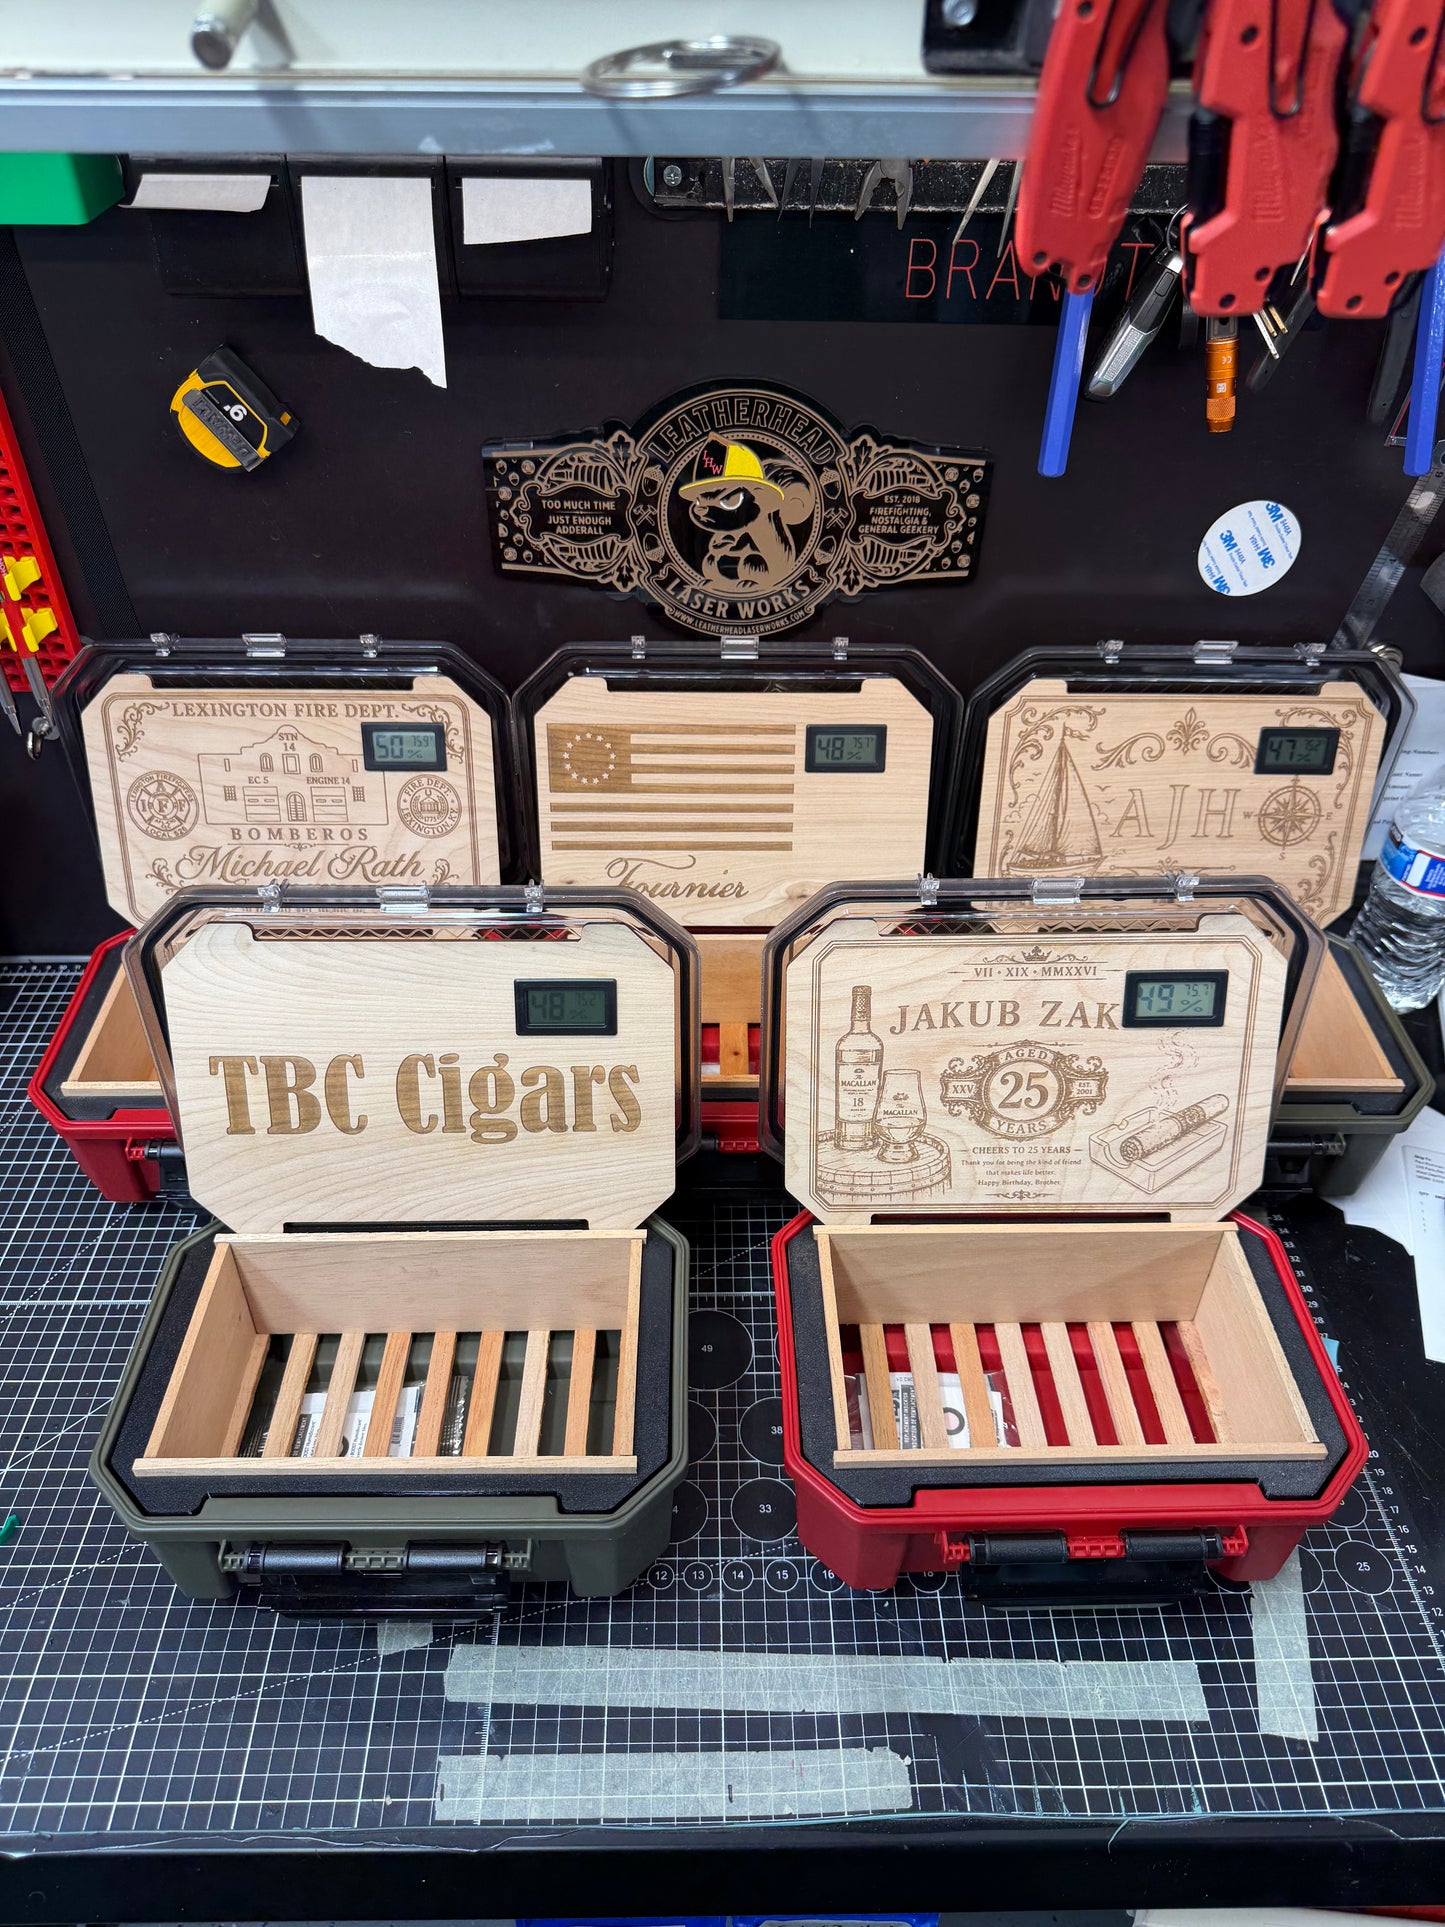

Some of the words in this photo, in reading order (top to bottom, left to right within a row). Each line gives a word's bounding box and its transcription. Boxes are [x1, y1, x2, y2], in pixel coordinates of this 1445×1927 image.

[649, 399, 835, 465] LEATHERHEAD
[884, 495, 900, 503] EST.
[902, 495, 921, 504] 2018
[541, 500, 561, 510] TOO
[563, 500, 591, 510] MUCH
[593, 500, 616, 511] TIME
[869, 507, 932, 517] FIREFIGHTING,
[1265, 503, 1284, 523] 3M
[548, 515, 570, 525] JUST
[572, 515, 611, 525] ENOUGH
[871, 516, 920, 525] NOSTALGIA
[921, 516, 928, 525] &
[556, 525, 604, 535] ADDERALL
[858, 525, 898, 534] GENERAL
[900, 525, 940, 534] GEEKERY
[1219, 530, 1238, 552] 3M
[1257, 547, 1275, 569] 3M
[1212, 575, 1231, 594] 3M
[665, 578, 729, 619] LASER
[736, 578, 811, 620] WORKS
[672, 607, 806, 637] WWW.LEATHERHEADLASERWORKS.COM
[172, 702, 288, 717] LEXINGTON
[294, 703, 339, 717] FIRE
[345, 703, 399, 718] DEPT.
[278, 732, 298, 741] STN
[283, 742, 296, 752] 14
[375, 734, 404, 759] 50
[817, 736, 845, 761] 48
[1269, 739, 1297, 762] 47
[248, 776, 262, 784] EC
[306, 777, 339, 785] ENGINE
[340, 777, 350, 785] 14
[403, 778, 425, 797] FIRE
[426, 778, 452, 797] DEPT.
[448, 807, 459, 822] KY
[145, 826, 171, 838] LOCAL
[231, 827, 368, 841] BOMBEROS
[175, 845, 325, 884] Michael
[327, 845, 425, 883] Rath
[604, 854, 749, 898] Fournier
[974, 967, 993, 978] VII
[1005, 967, 1029, 977] XIX
[1041, 966, 1097, 977] MMXXVI
[1138, 984, 1175, 1013] 49
[531, 991, 565, 1020] 48
[889, 1000, 1021, 1036] JAKUB
[1039, 1000, 1120, 1031] ZAK
[1004, 1048, 1049, 1061] AGED
[952, 1084, 975, 1095] XXV
[998, 1070, 1050, 1110] 25
[208, 1053, 369, 1136] TBC
[396, 1053, 641, 1145] Cigars
[853, 1097, 864, 1107] 18
[993, 1119, 1049, 1135] YEARS
[972, 1146, 1009, 1155] CHEERS
[1012, 1146, 1025, 1154] TO
[1028, 1146, 1039, 1154] 25
[1041, 1146, 1071, 1154] YEARS
[1007, 1159, 1024, 1167] being
[1289, 1255, 1301, 1263] 32
[1301, 1285, 1314, 1293] 30
[701, 1345, 713, 1353] 49
[770, 1426, 783, 1435] 38
[1373, 1468, 1385, 1477] 19
[1381, 1487, 1394, 1495] 18
[759, 1504, 772, 1513] 33
[1389, 1506, 1399, 1514] 17
[1397, 1525, 1410, 1534] 16
[1405, 1544, 1417, 1554] 15
[1356, 1562, 1371, 1572] 25
[1414, 1565, 1426, 1574] 14
[655, 1571, 668, 1580] 12
[692, 1570, 705, 1580] 13
[732, 1570, 744, 1580] 14
[775, 1570, 789, 1580] 15
[822, 1569, 835, 1579] 16
[1422, 1586, 1435, 1595] 13
[1431, 1608, 1444, 1617] 12
